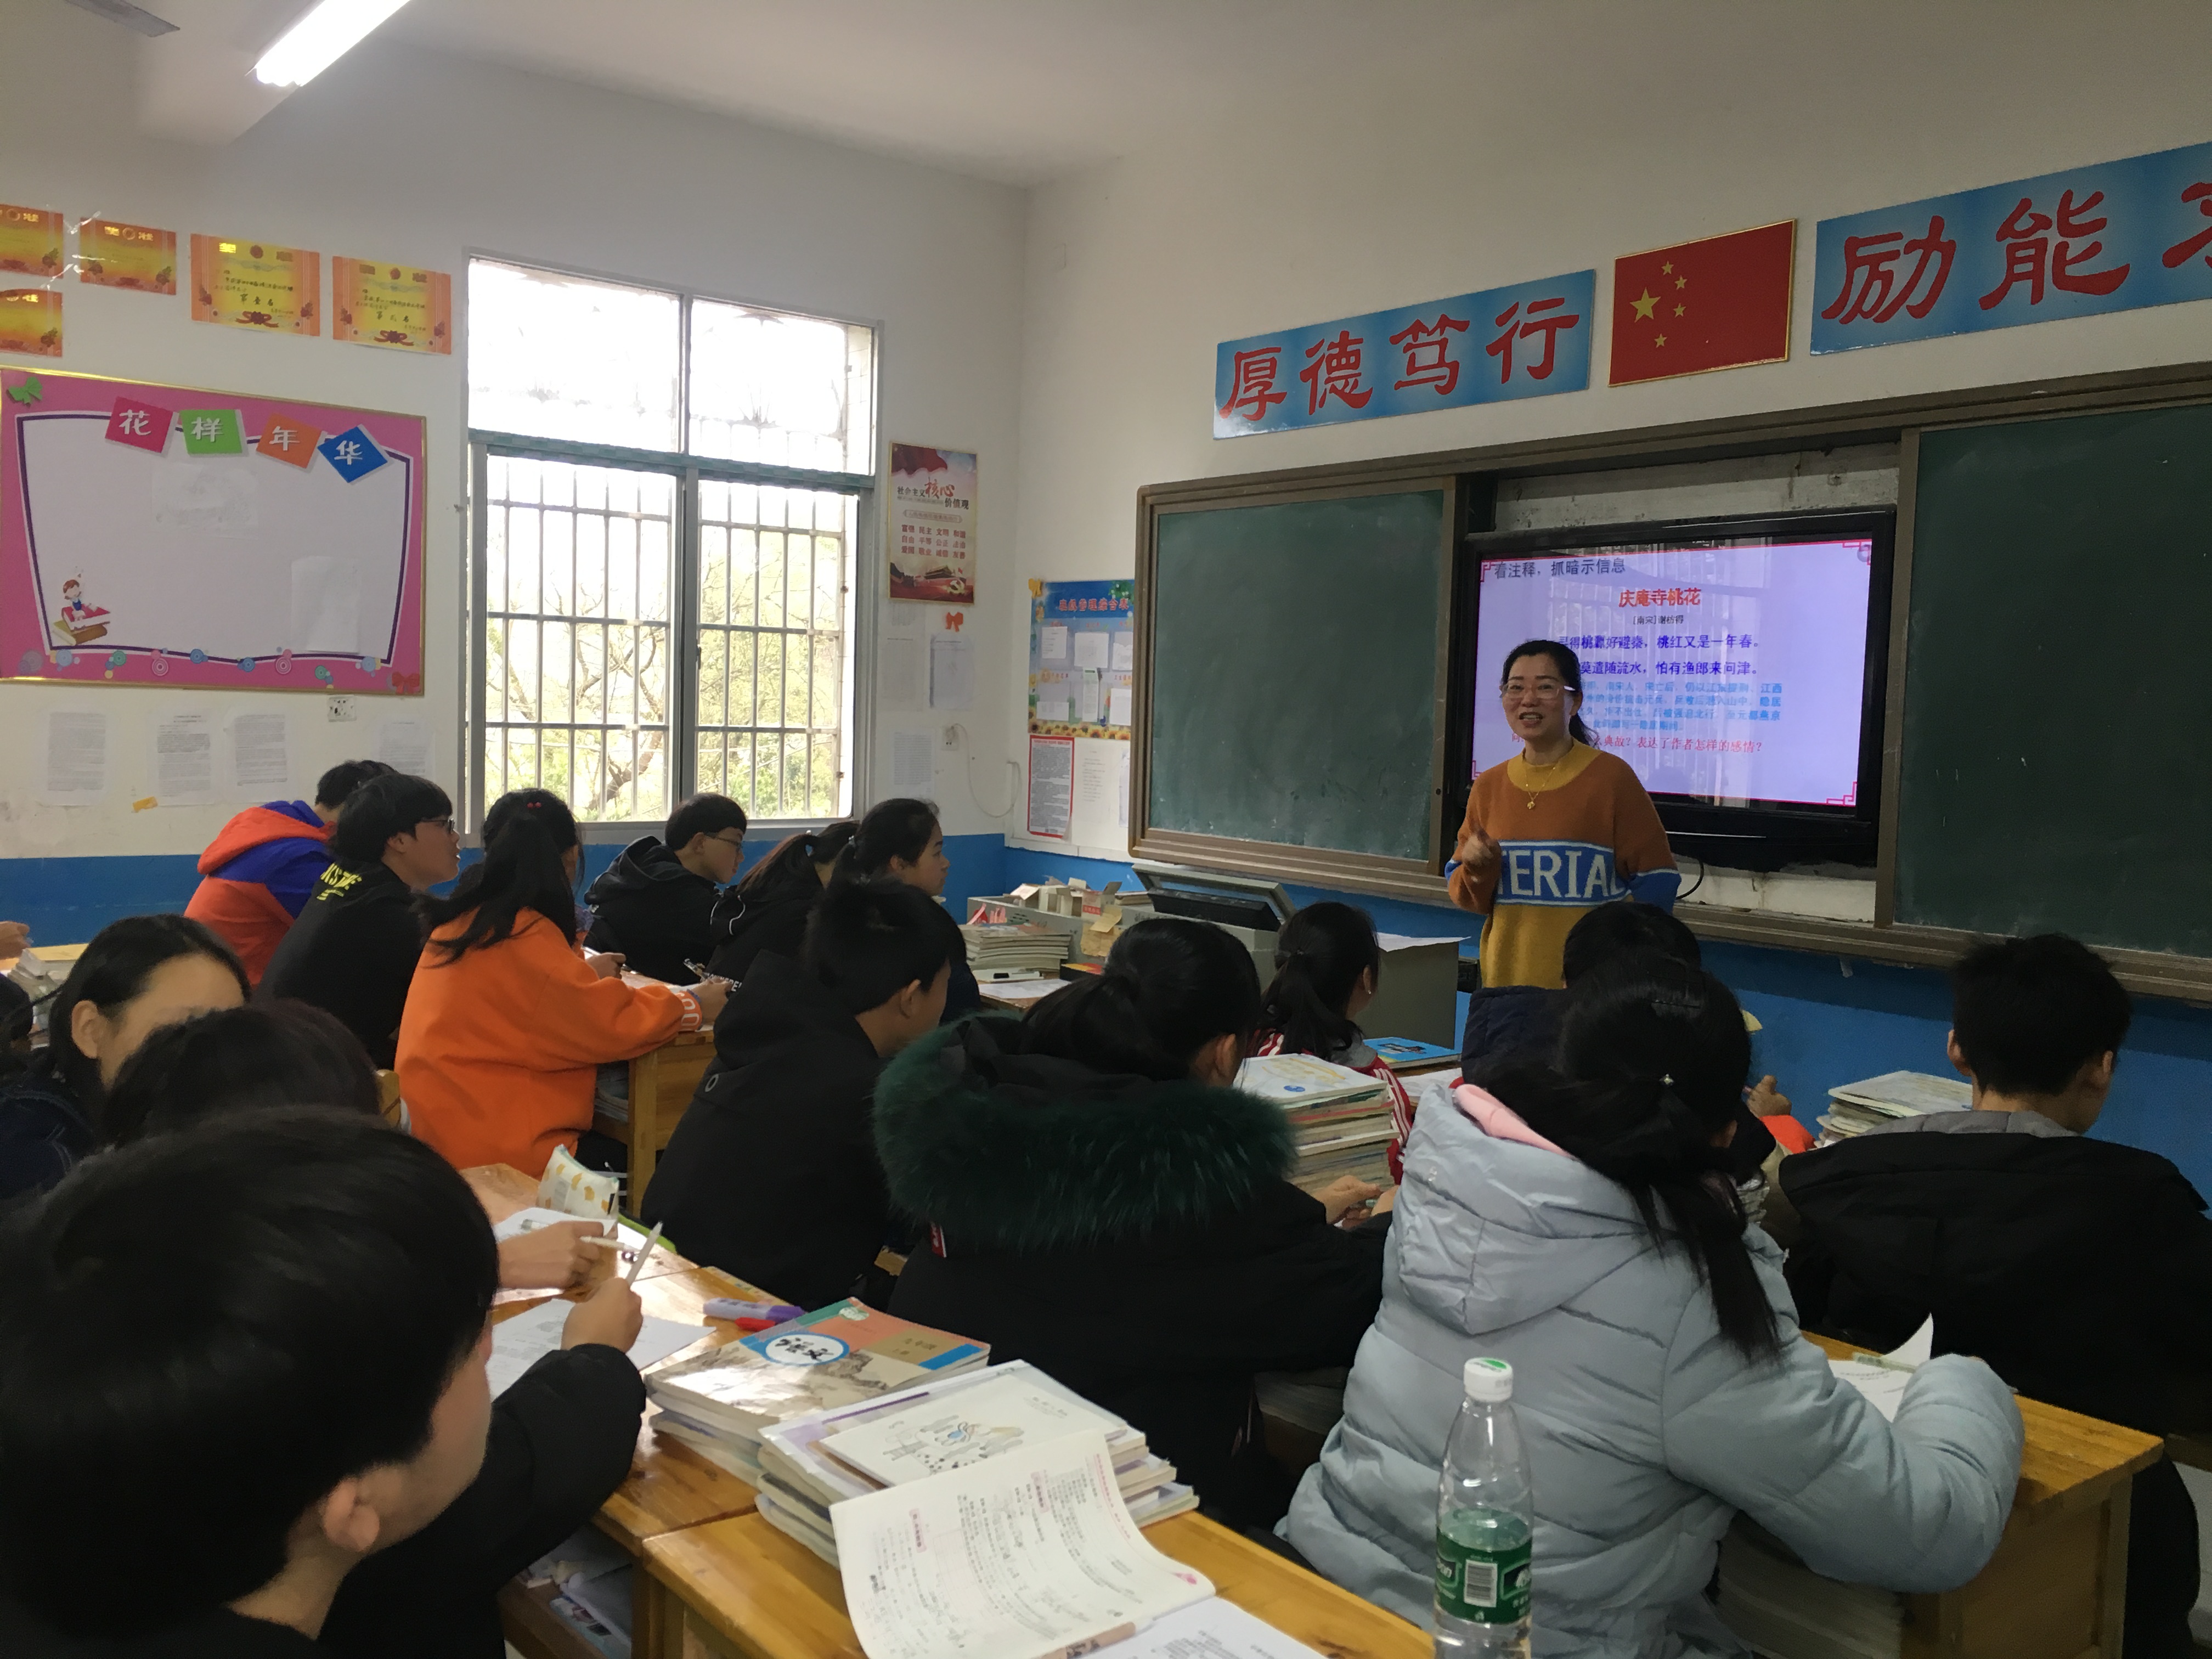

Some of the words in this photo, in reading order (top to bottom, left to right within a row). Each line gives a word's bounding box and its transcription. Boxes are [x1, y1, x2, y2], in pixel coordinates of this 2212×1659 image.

[1219, 297, 1579, 421] 厚德笃行
[119, 409, 363, 465] 花样年华
[924, 476, 955, 499] 核心
[1618, 587, 1702, 607] 庆庵寺桃花
